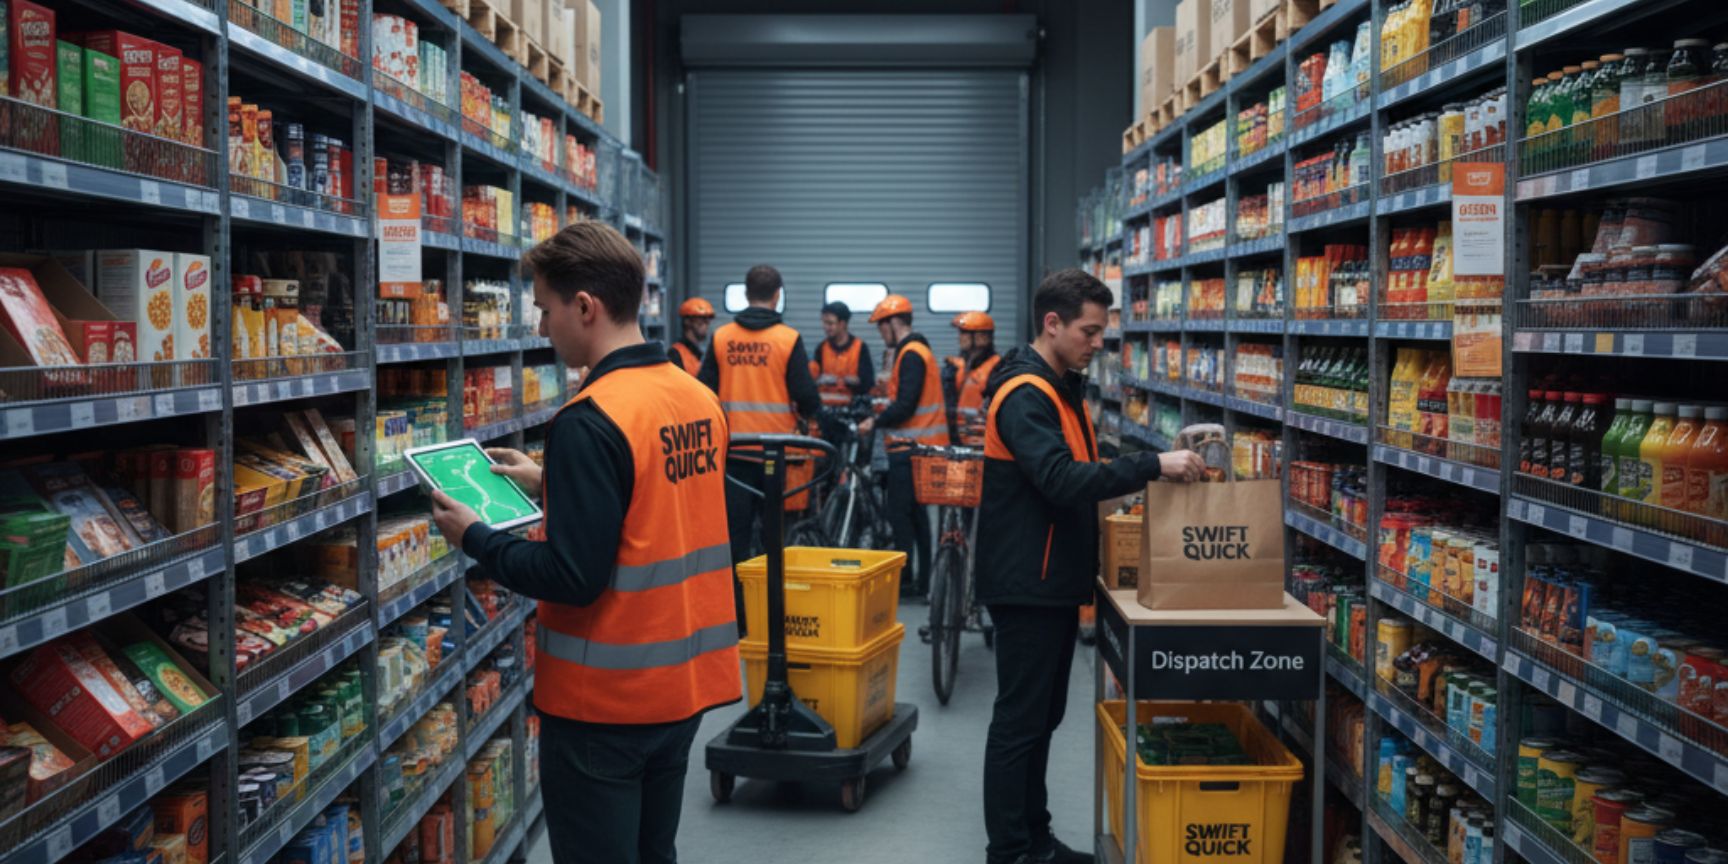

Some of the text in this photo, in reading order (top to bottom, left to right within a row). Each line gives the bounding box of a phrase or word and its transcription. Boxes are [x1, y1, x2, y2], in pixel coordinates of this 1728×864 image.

[659, 418, 712, 455] SWIFT
[665, 447, 718, 484] QUICK
[1182, 526, 1249, 542] SWIFT
[1183, 543, 1251, 561] QUICK
[1151, 650, 1304, 675] Dispatch Zone
[1184, 839, 1252, 857] QUICK
